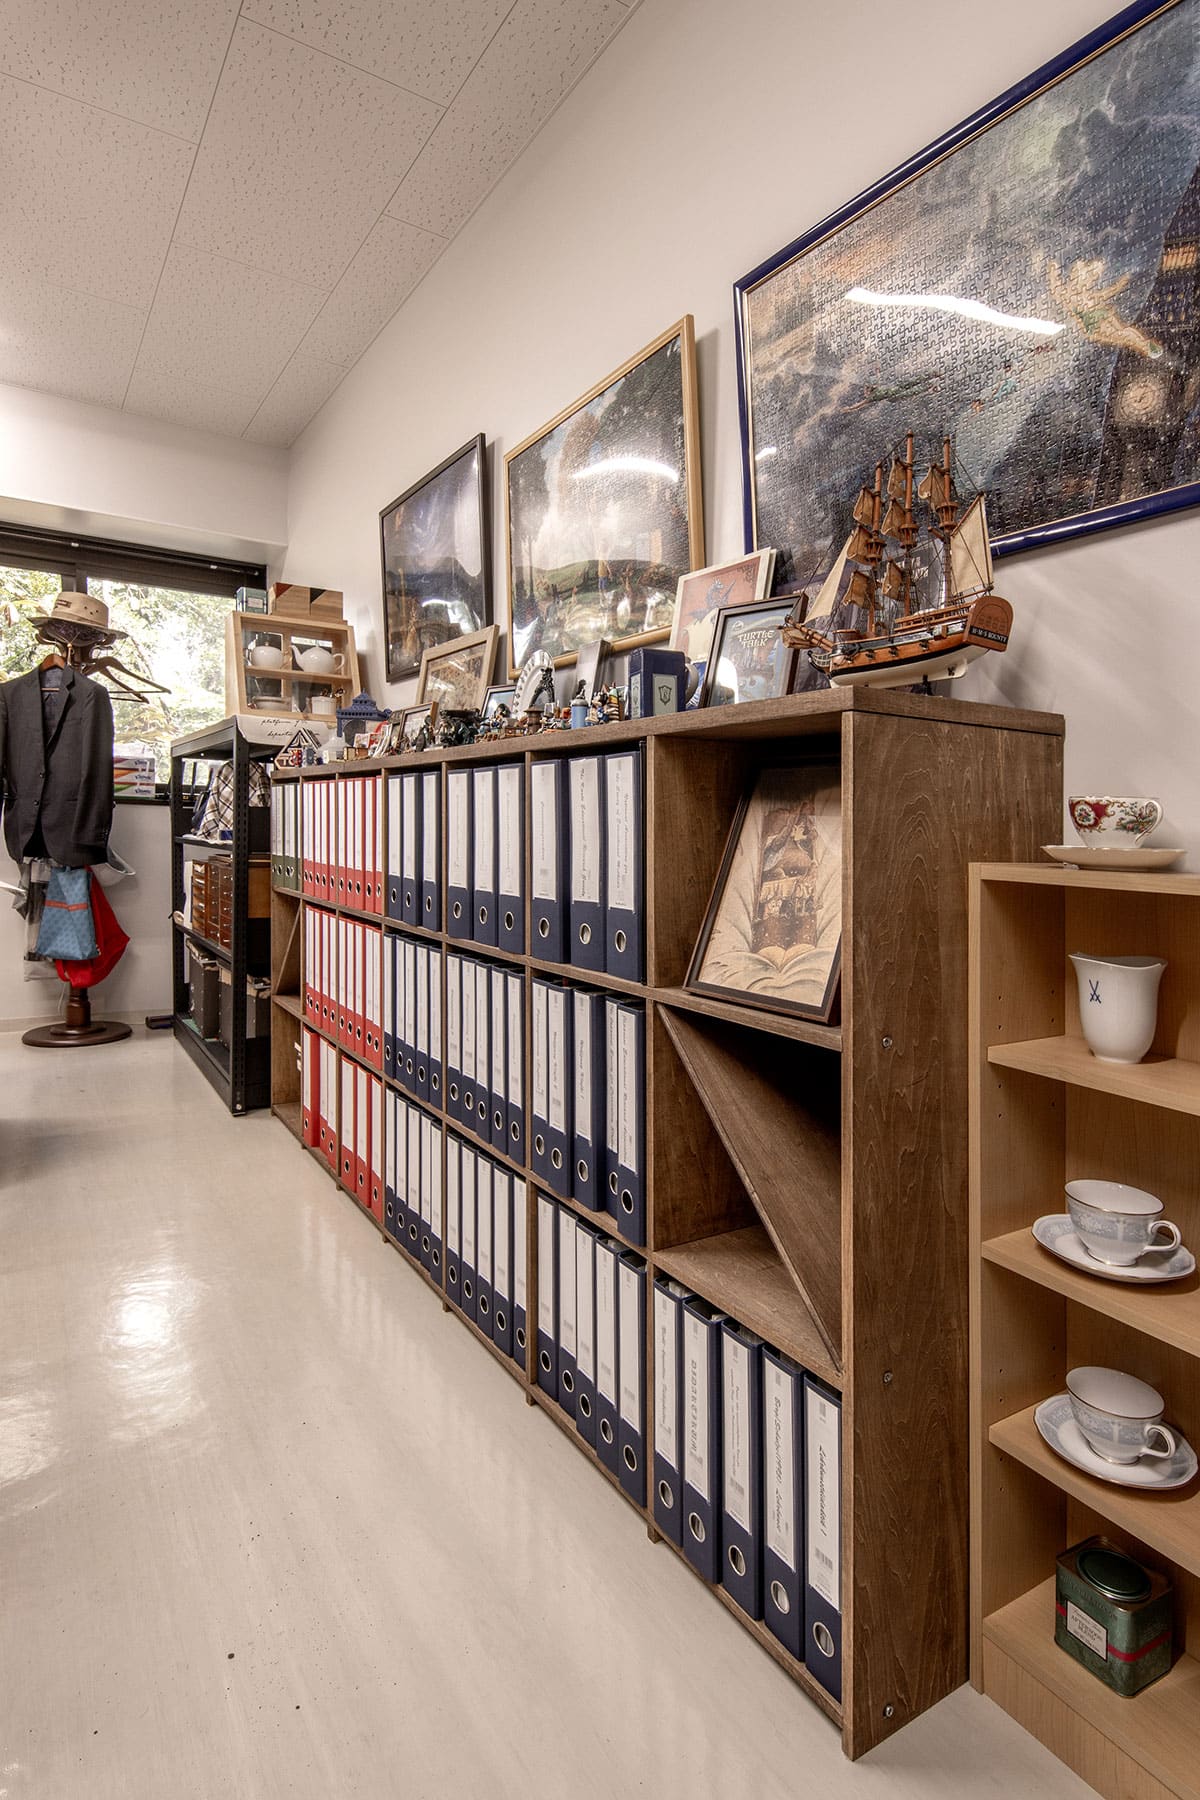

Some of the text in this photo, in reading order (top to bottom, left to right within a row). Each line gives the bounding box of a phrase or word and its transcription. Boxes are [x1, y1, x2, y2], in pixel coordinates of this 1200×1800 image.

[738, 630, 775, 642] TURTLE
[988, 632, 1008, 642] BOUNTY
[742, 639, 768, 648] TALK
